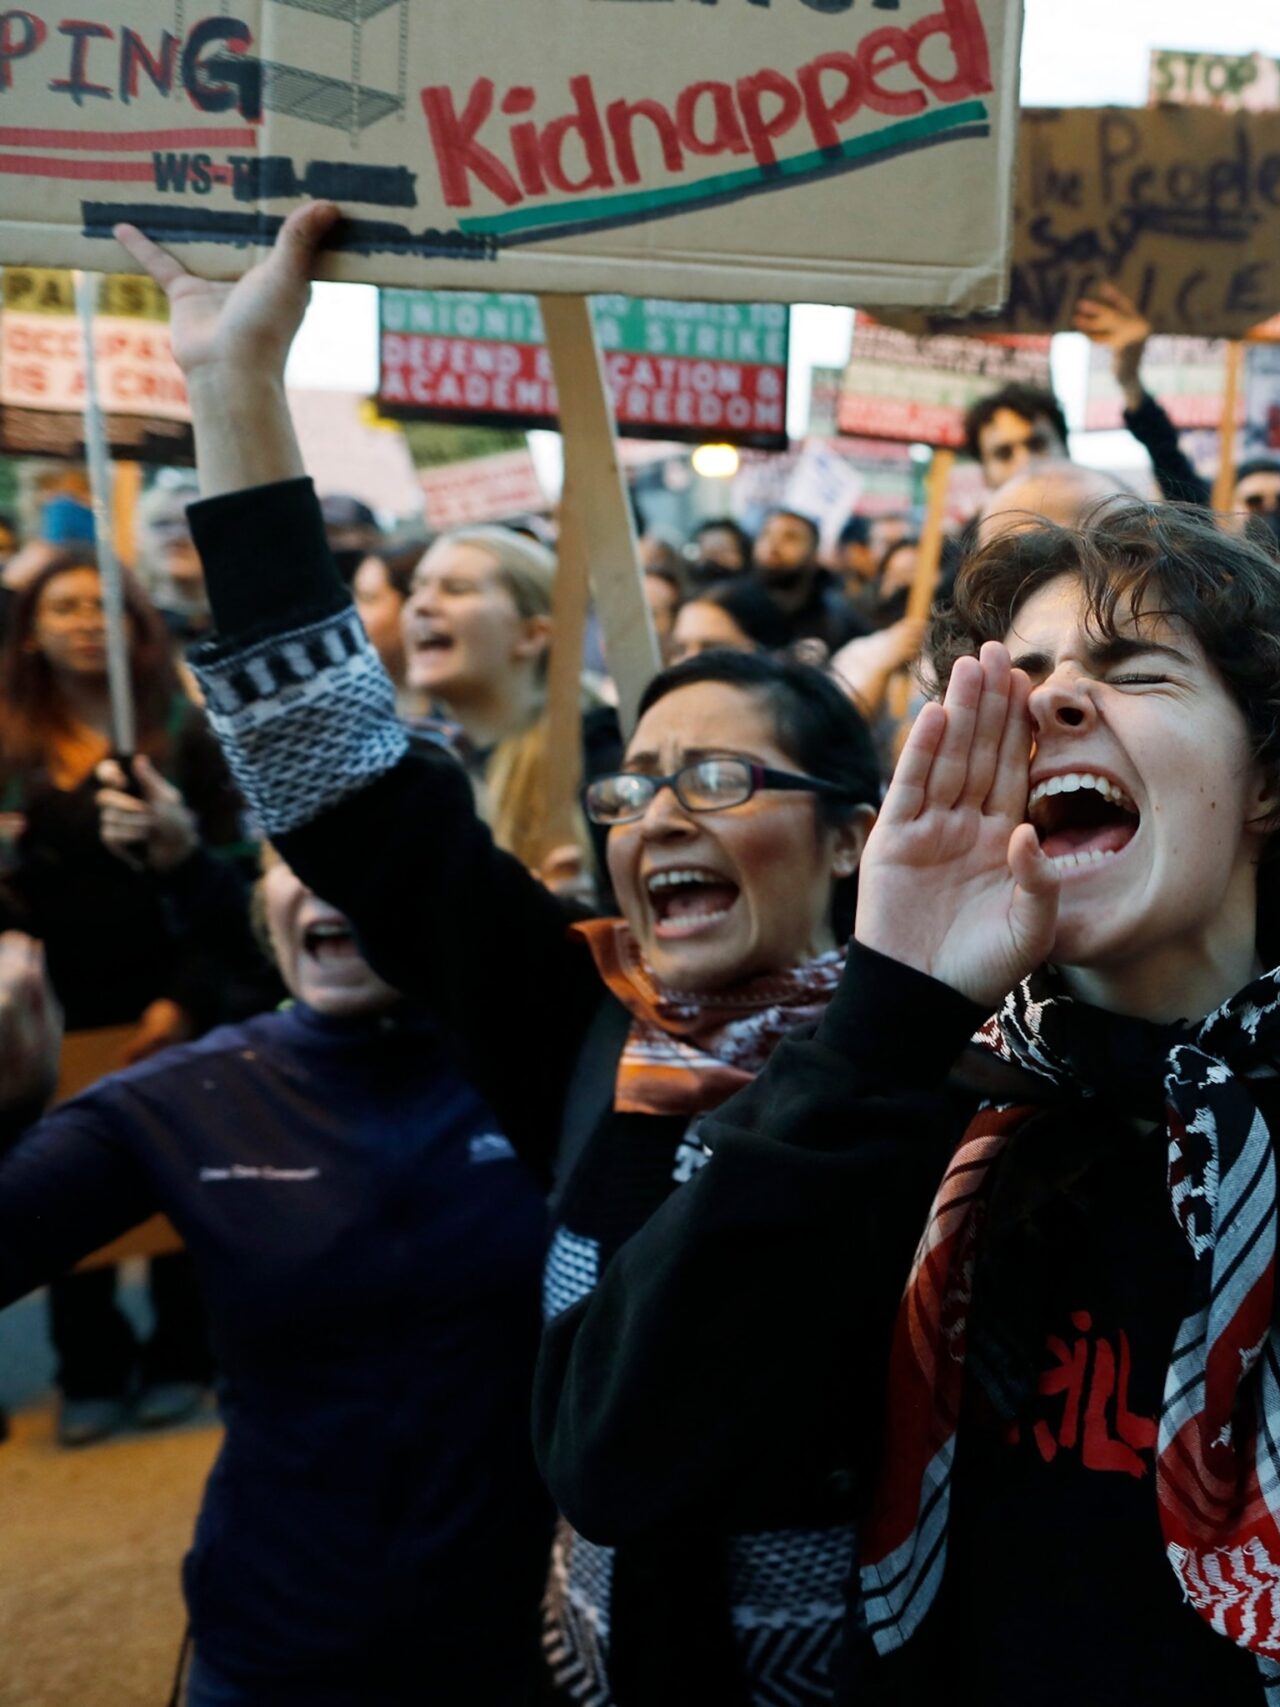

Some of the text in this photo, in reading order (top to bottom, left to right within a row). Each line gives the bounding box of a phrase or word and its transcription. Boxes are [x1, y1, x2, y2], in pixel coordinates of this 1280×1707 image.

[420, 0, 992, 207] Kidnapped
[1156, 54, 1256, 93] STOP
[382, 299, 546, 345] UNIONI
[645, 320, 787, 363] STRIKE
[382, 333, 522, 376] DEFEND
[534, 347, 743, 394] ECATION
[382, 369, 560, 415] ACADEMI
